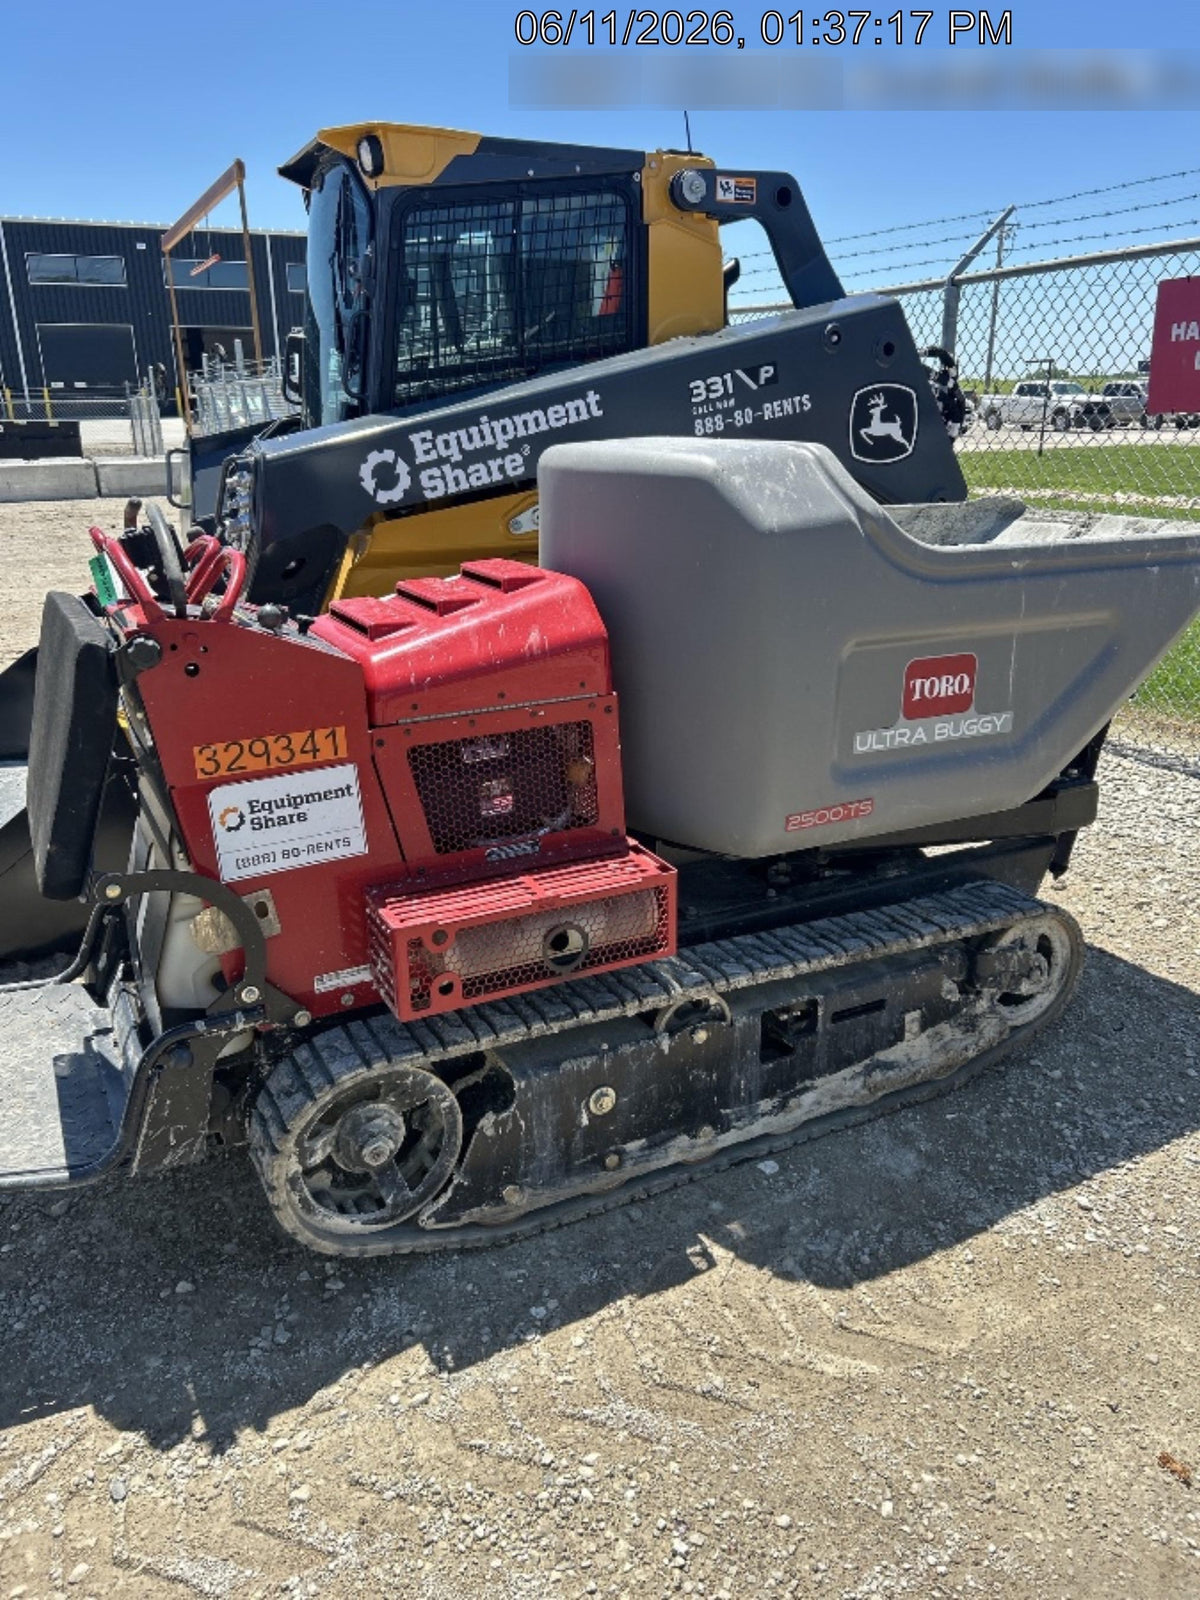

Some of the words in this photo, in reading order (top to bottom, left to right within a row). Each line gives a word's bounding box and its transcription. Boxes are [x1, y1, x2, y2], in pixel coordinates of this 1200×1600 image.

[408, 390, 604, 462] Equipment
[694, 394, 812, 436] 888-80-RENTS
[855, 727, 928, 751] ULTRA
[934, 714, 1008, 741] BUGGY
[198, 727, 339, 776] 329341
[247, 783, 354, 815] Equipment
[249, 811, 309, 832] Share
[281, 836, 351, 859] 80-RENTS
